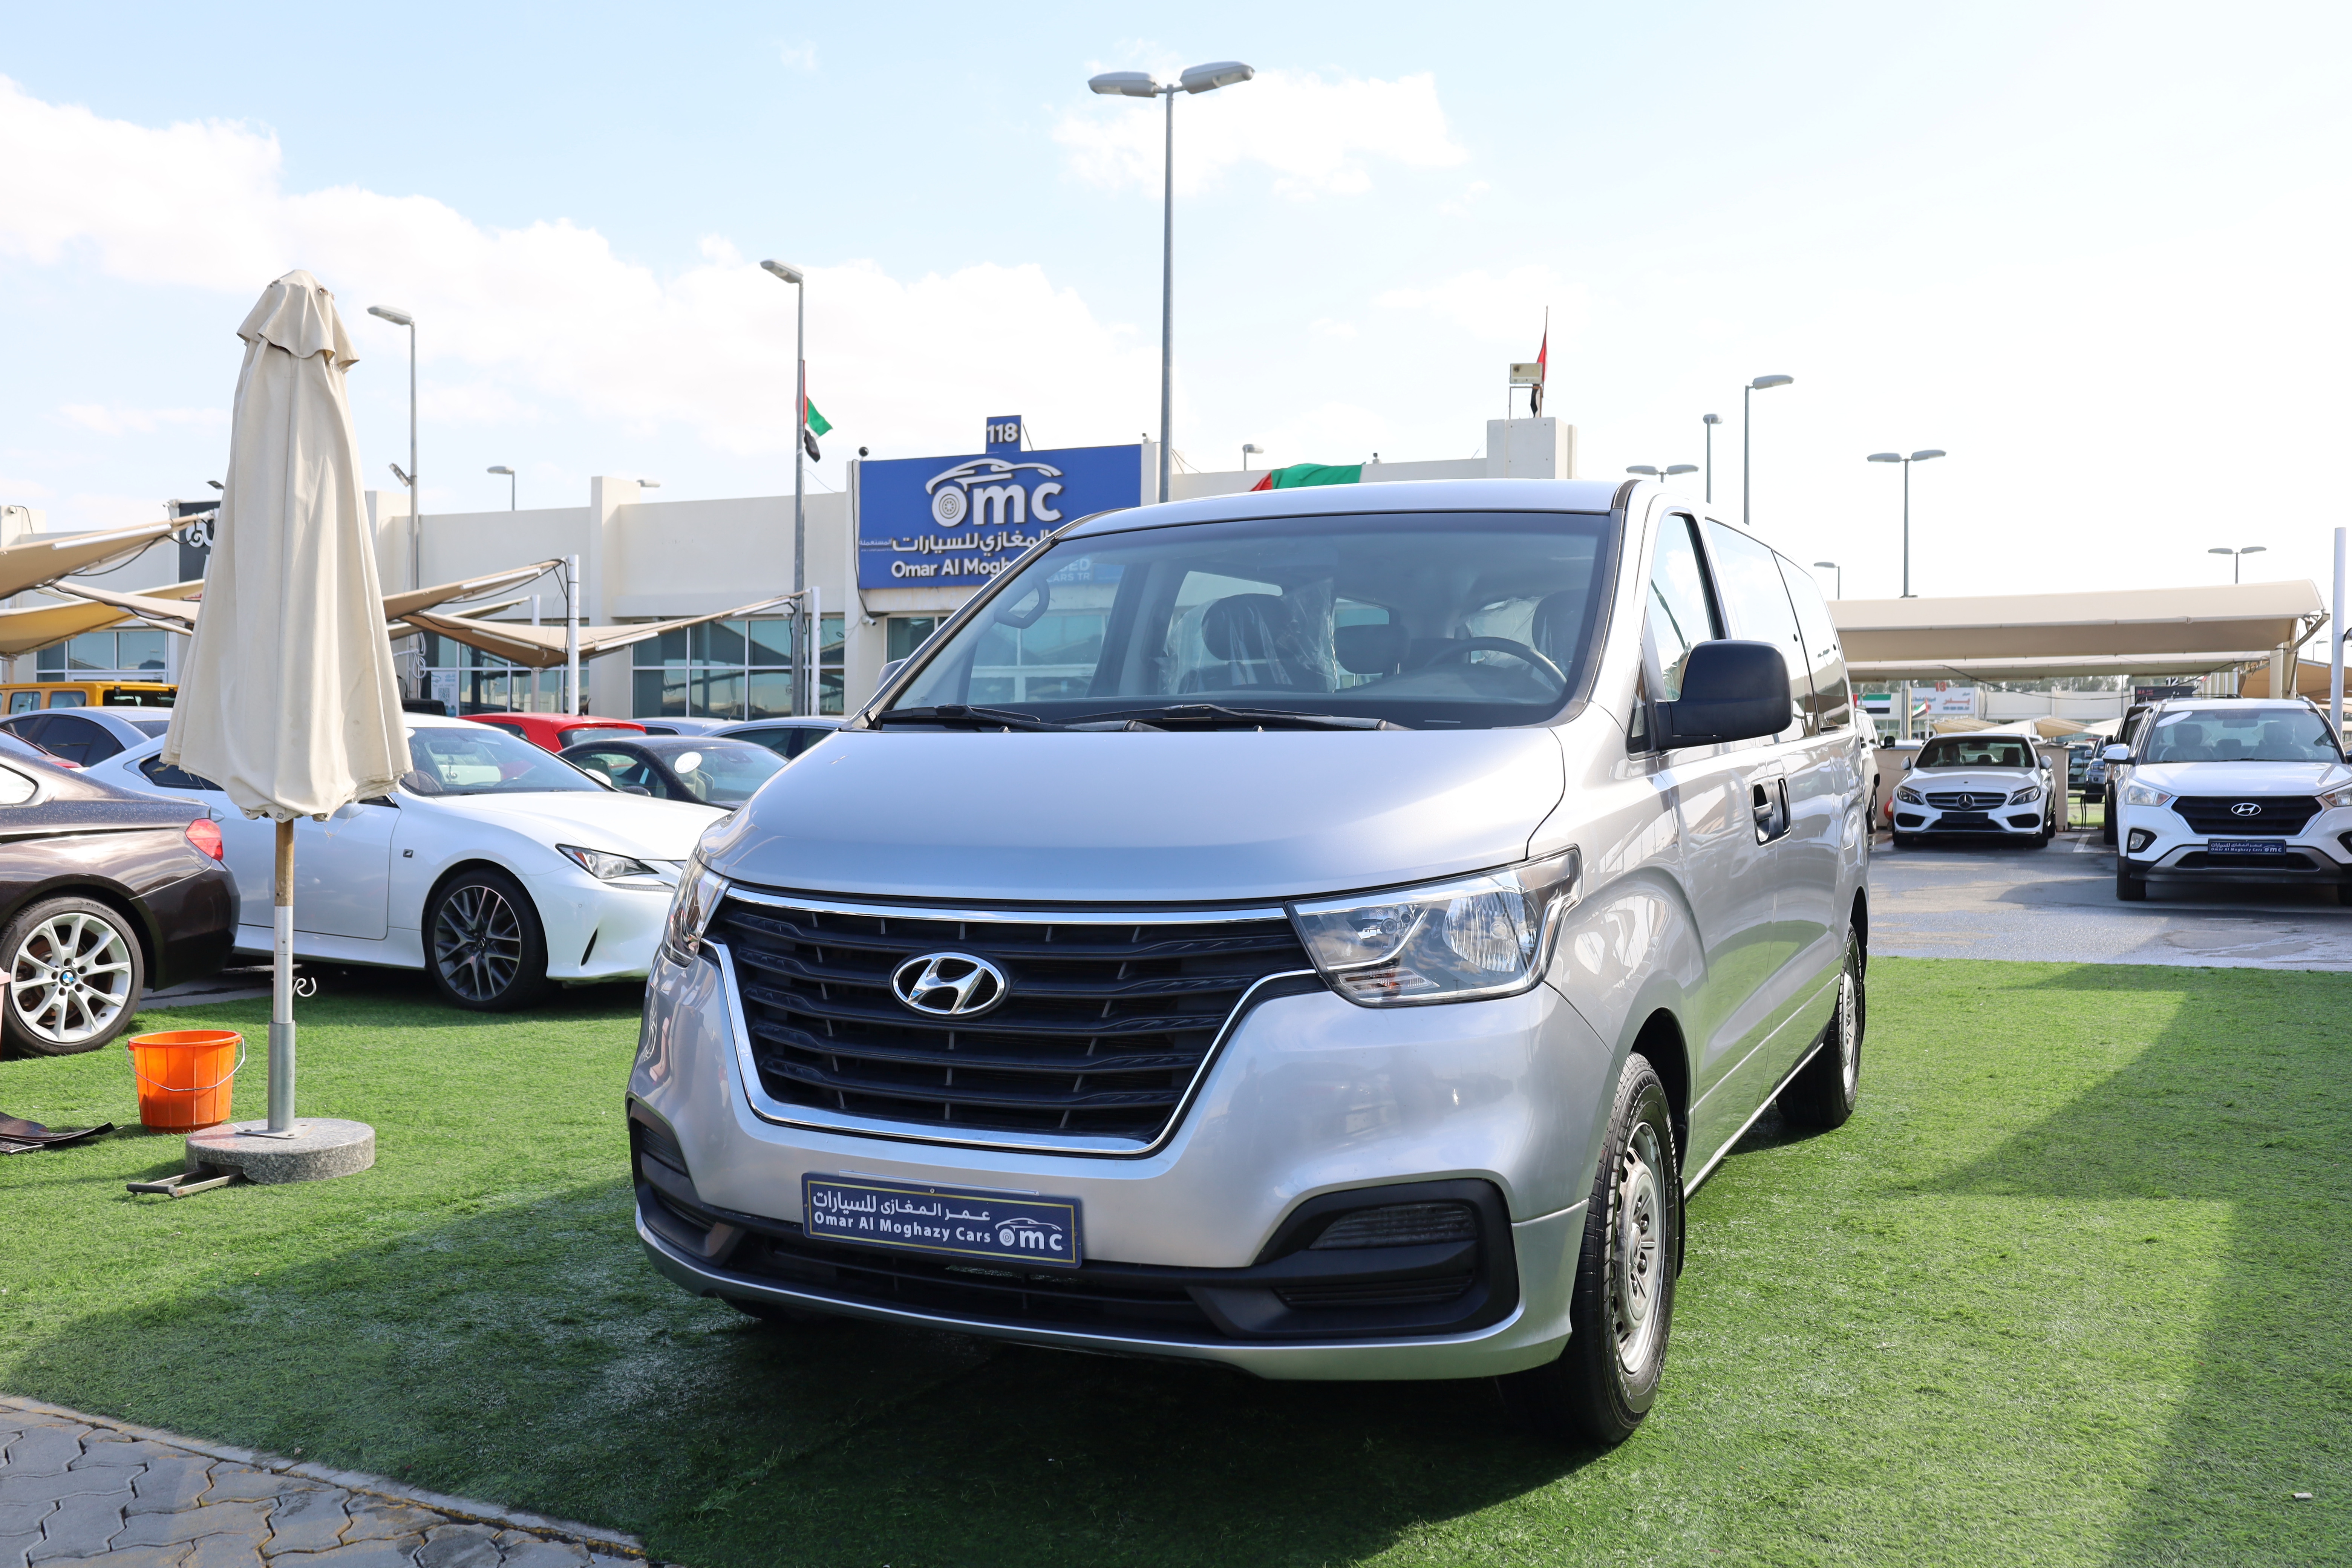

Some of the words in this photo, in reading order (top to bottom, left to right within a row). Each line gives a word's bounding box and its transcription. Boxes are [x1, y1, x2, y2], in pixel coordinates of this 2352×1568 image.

[987, 423, 1018, 443] 118
[892, 533, 979, 554] للسيارات
[891, 561, 937, 578] Omar
[942, 558, 959, 576] Al
[1935, 681, 1946, 692] 13
[2166, 677, 2179, 687] 12
[85, 902, 114, 916] DUNLOP
[813, 1190, 877, 1215] للسيارات
[945, 1209, 990, 1221] عمر
[815, 1211, 854, 1228] Omar
[859, 1216, 874, 1230] Al
[880, 1219, 950, 1242] Moghazy
[956, 1227, 991, 1243] Cars
